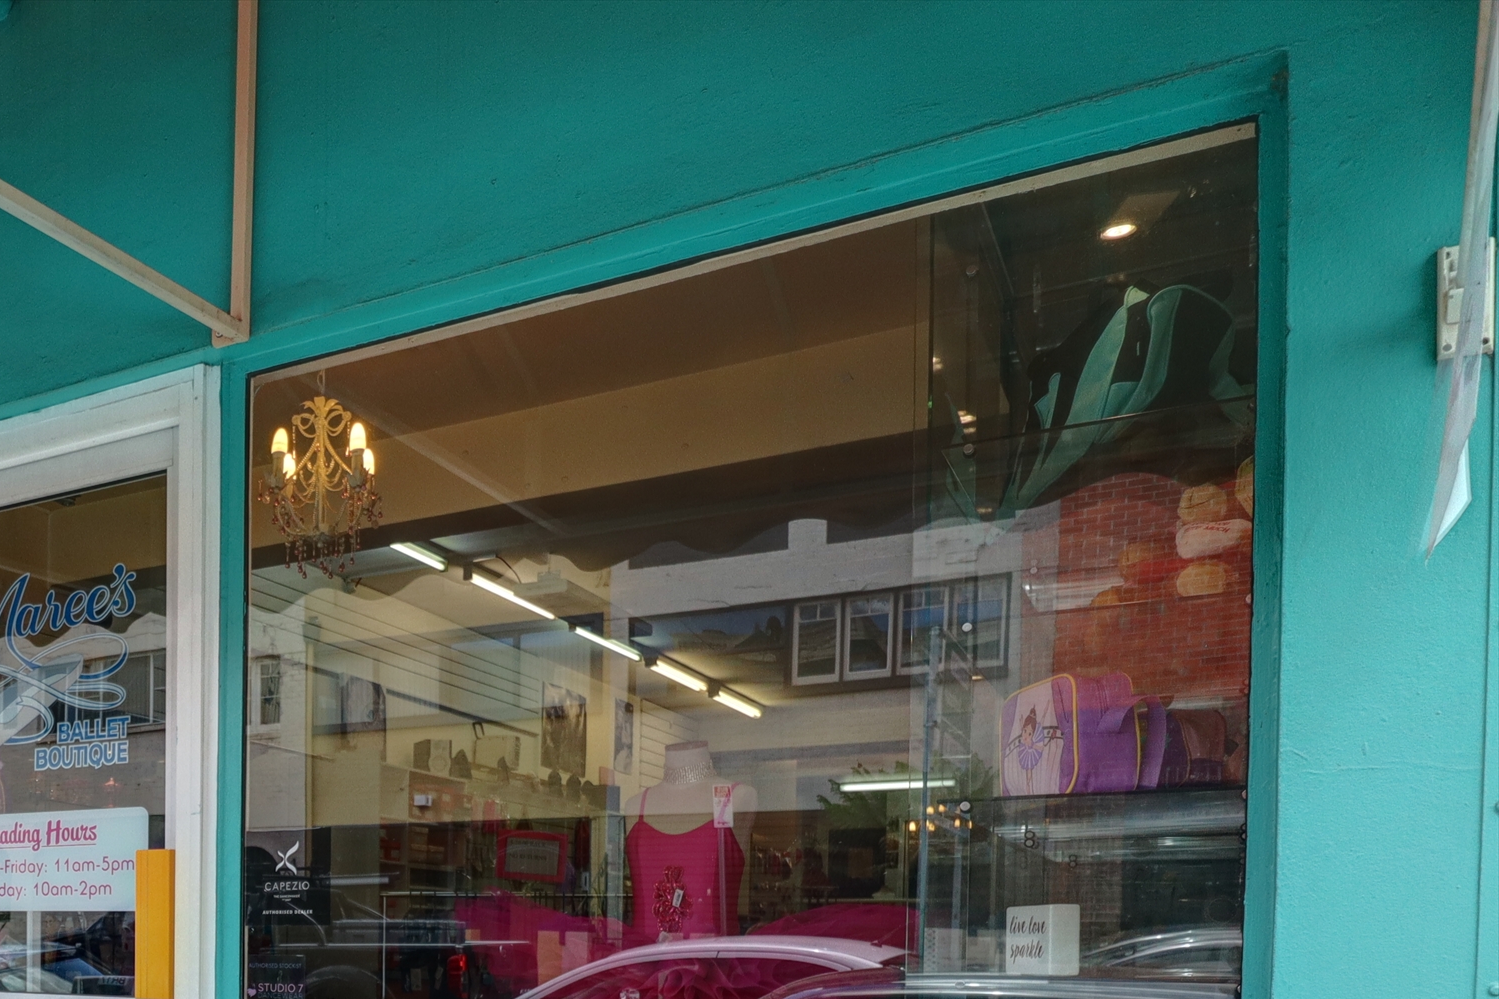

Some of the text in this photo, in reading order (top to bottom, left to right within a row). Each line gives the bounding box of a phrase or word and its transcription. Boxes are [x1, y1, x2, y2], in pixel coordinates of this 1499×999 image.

[56, 715, 131, 745] BALLET
[34, 740, 129, 772] BOUTIQUE
[46, 820, 98, 846] Hours
[54, 855, 135, 875] 11am-5pm
[33, 880, 112, 899] 10am-2pm
[264, 881, 310, 891] CAPEZIO
[1009, 915, 1047, 934] live love
[1009, 939, 1045, 964] sparkle
[257, 983, 304, 992] STUDIO 7
